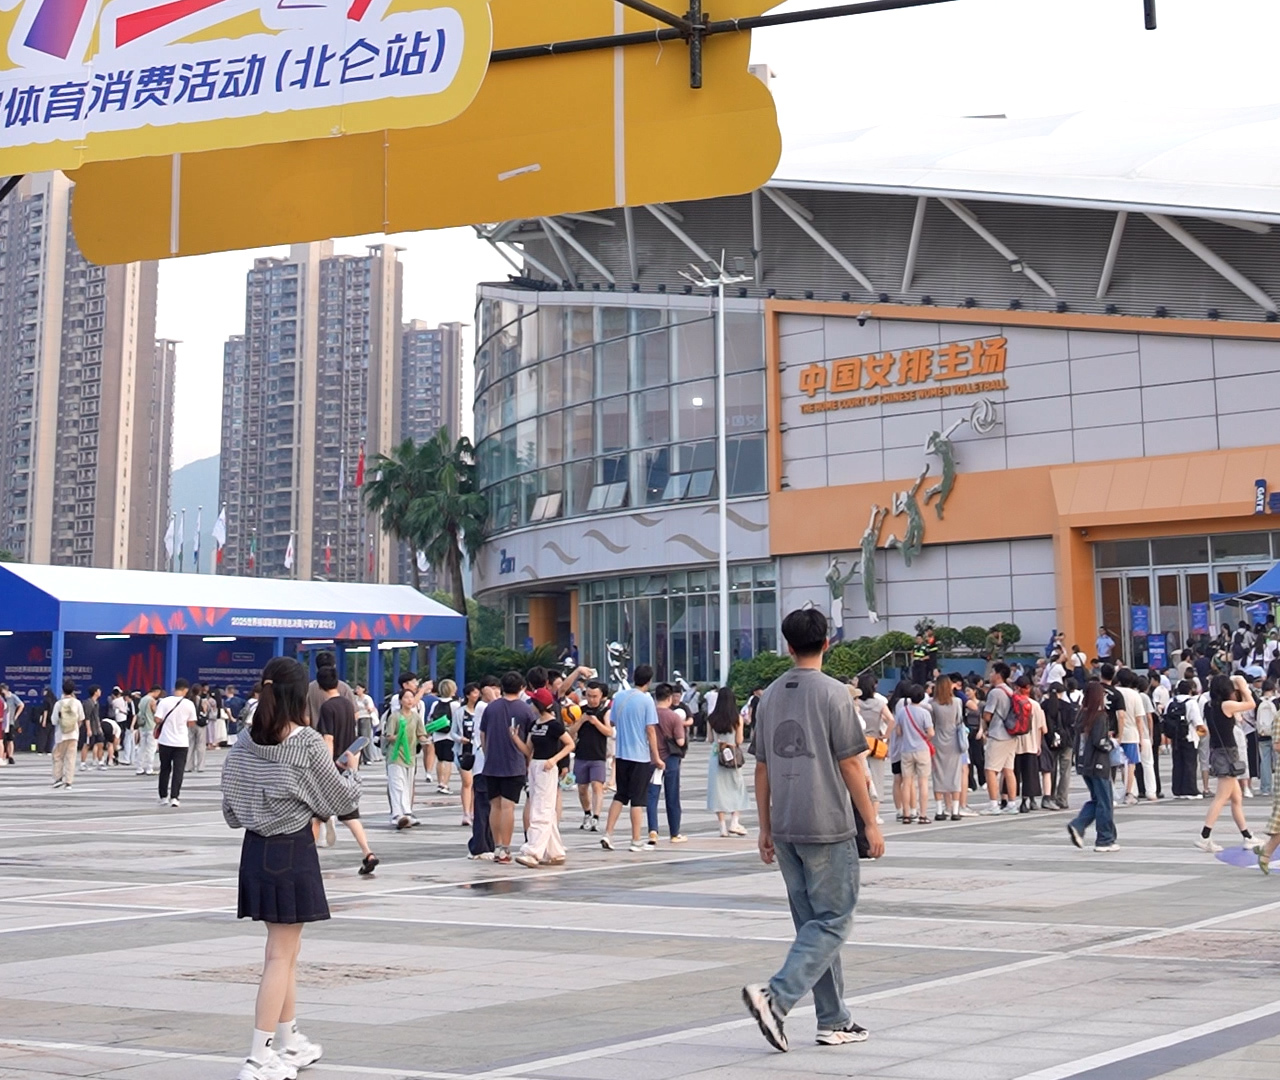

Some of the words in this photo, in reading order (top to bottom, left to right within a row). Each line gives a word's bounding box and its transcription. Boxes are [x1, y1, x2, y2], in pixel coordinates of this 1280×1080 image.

[798, 337, 1008, 399] 中国女排主场
[880, 390, 917, 404] CHINESE
[952, 379, 1009, 396] VOLLEYBALL
[1256, 487, 1265, 512] GATE
